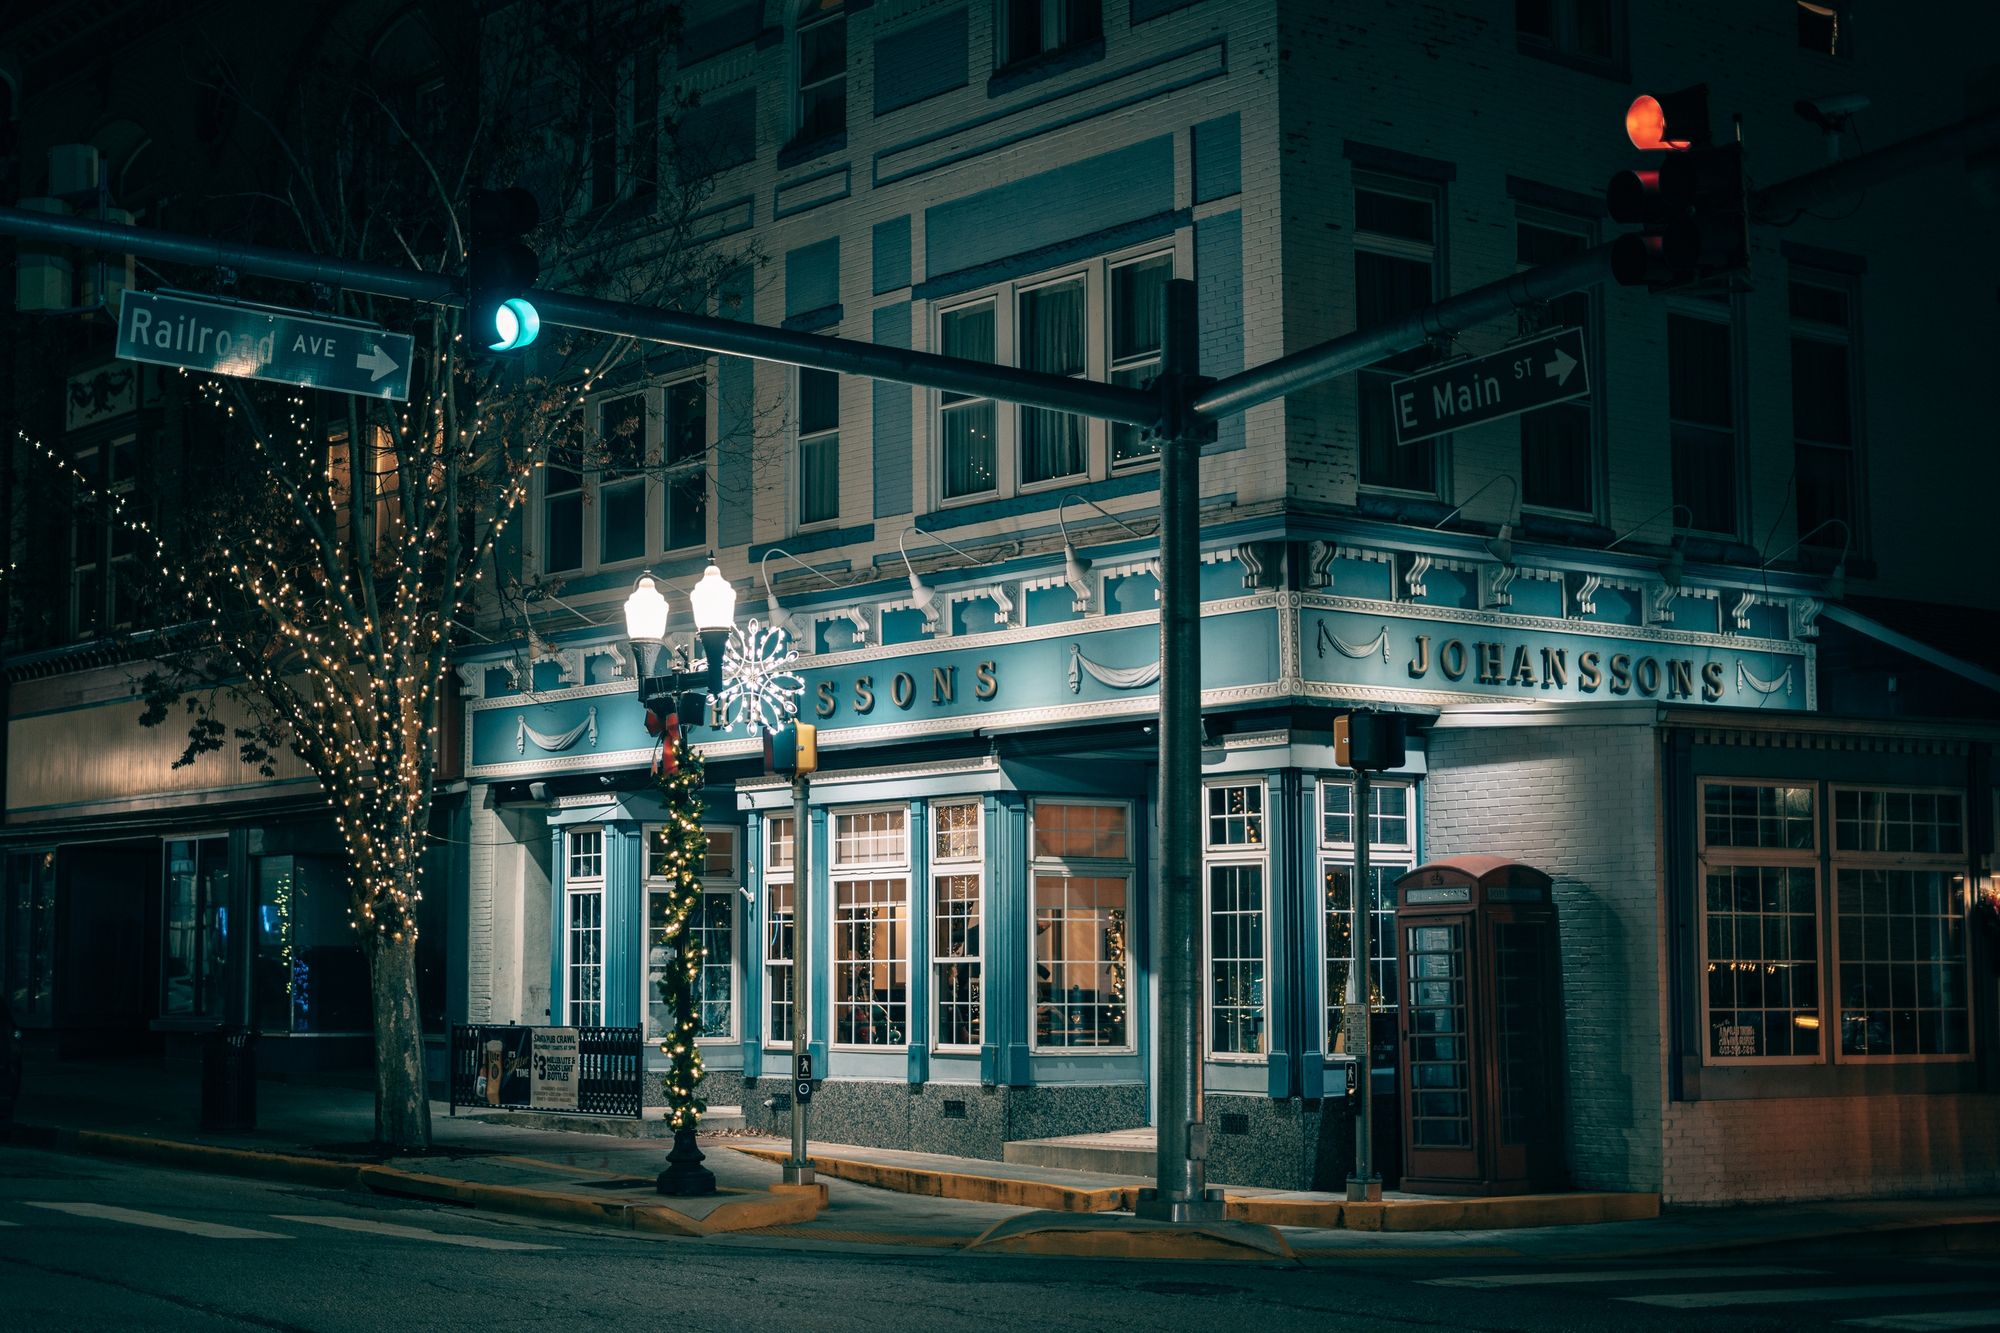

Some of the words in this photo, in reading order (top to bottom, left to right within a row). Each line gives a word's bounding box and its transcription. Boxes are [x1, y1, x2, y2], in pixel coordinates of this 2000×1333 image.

[130, 308, 275, 365] Railroad
[293, 334, 337, 358] AVE
[1400, 393, 1418, 428] E
[1433, 373, 1501, 419] Main
[1514, 358, 1533, 379] ST
[1410, 635, 1725, 700] JOHANSSONS
[556, 1035, 576, 1043] CRAWL
[516, 1068, 529, 1078] TIME
[534, 1052, 546, 1080] $3
[547, 1072, 569, 1081] BOTTLES
